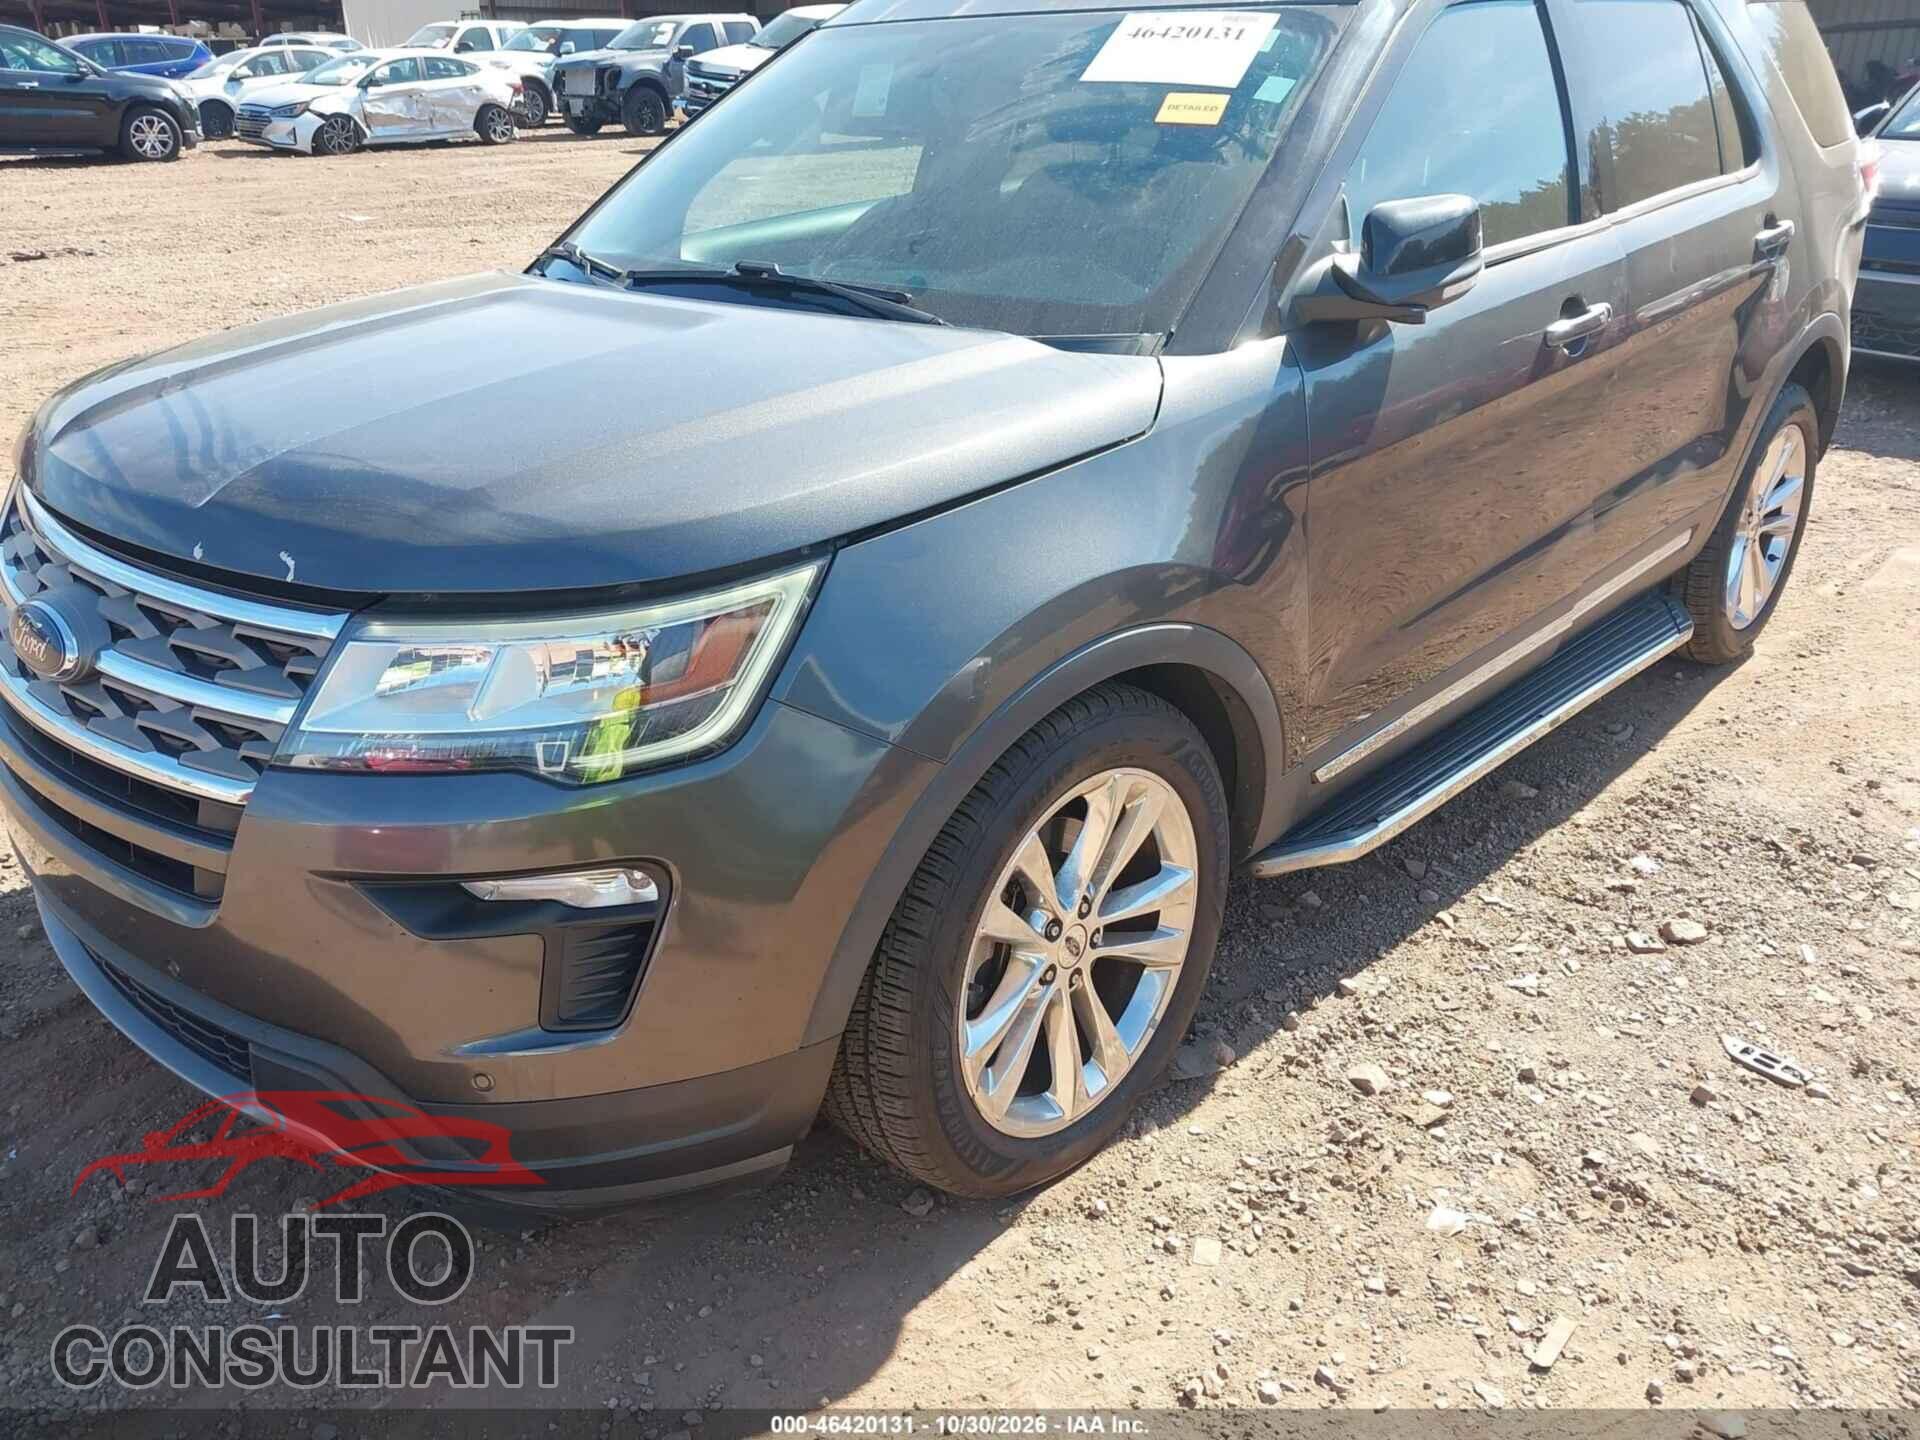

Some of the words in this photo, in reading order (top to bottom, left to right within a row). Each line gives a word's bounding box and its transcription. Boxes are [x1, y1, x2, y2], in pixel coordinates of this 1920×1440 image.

[1128, 26, 1246, 40] 46420131
[1167, 103, 1219, 112] DETAILED
[15, 613, 48, 662] Ford
